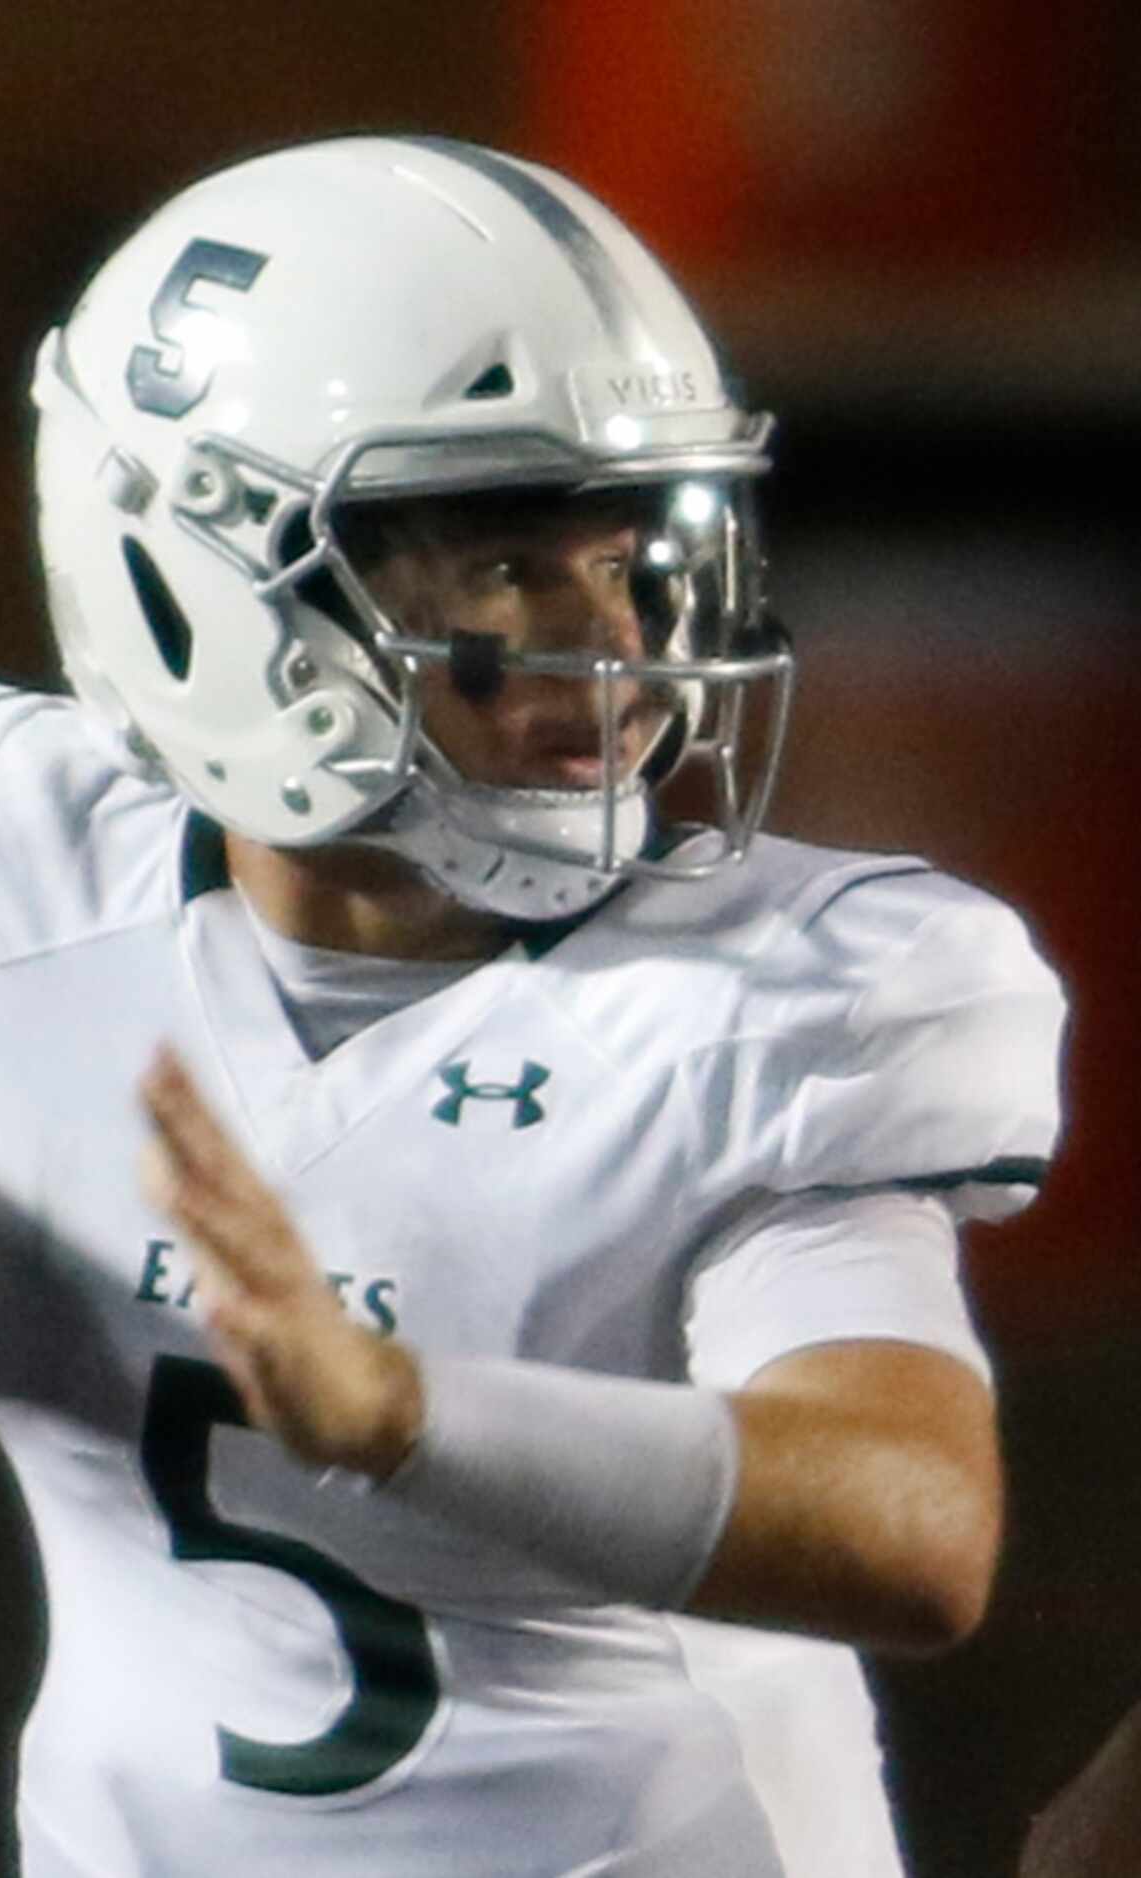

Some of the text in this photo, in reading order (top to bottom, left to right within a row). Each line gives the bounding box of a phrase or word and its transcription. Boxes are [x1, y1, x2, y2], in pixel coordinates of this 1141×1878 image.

[126, 236, 270, 421] 5
[606, 371, 697, 405] VICIS
[140, 1353, 444, 1798] 5
